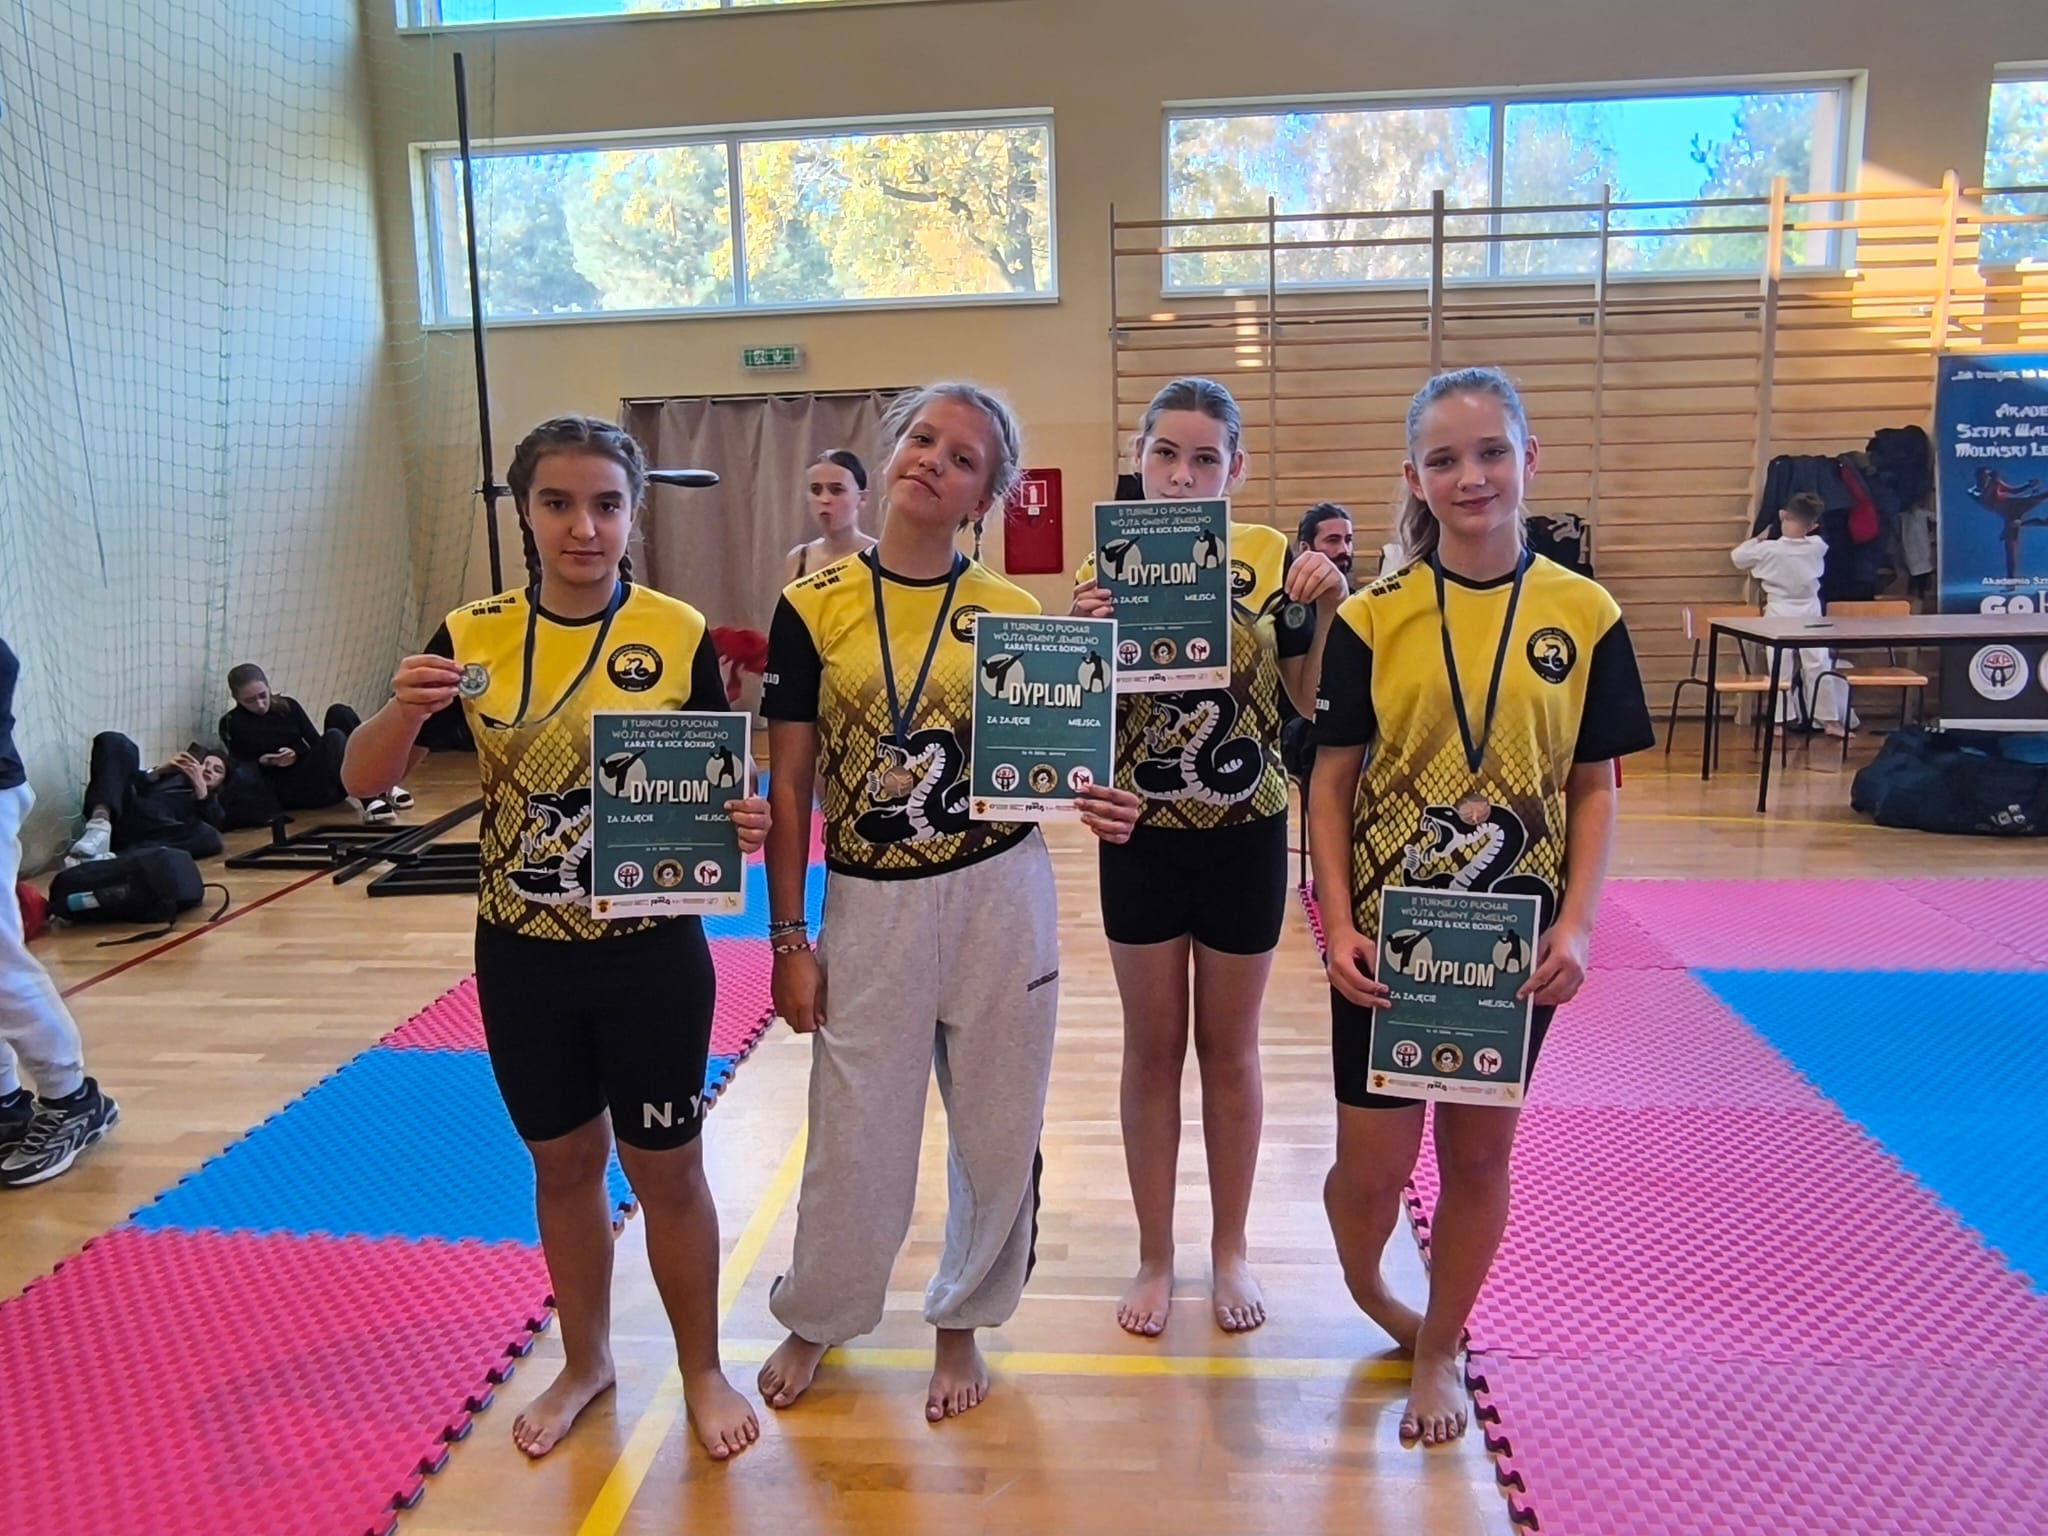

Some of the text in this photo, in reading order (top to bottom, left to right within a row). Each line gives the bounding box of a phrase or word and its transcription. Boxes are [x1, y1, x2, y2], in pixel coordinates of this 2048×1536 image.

[1128, 562, 1197, 586] DYPLOM
[1009, 682, 1081, 708] DYPLOM
[986, 715, 998, 724] ZA
[629, 779, 709, 803] DYPLOM
[607, 815, 619, 824] ZA
[1414, 959, 1495, 988] DYPLOM
[1390, 990, 1401, 999] ZA
